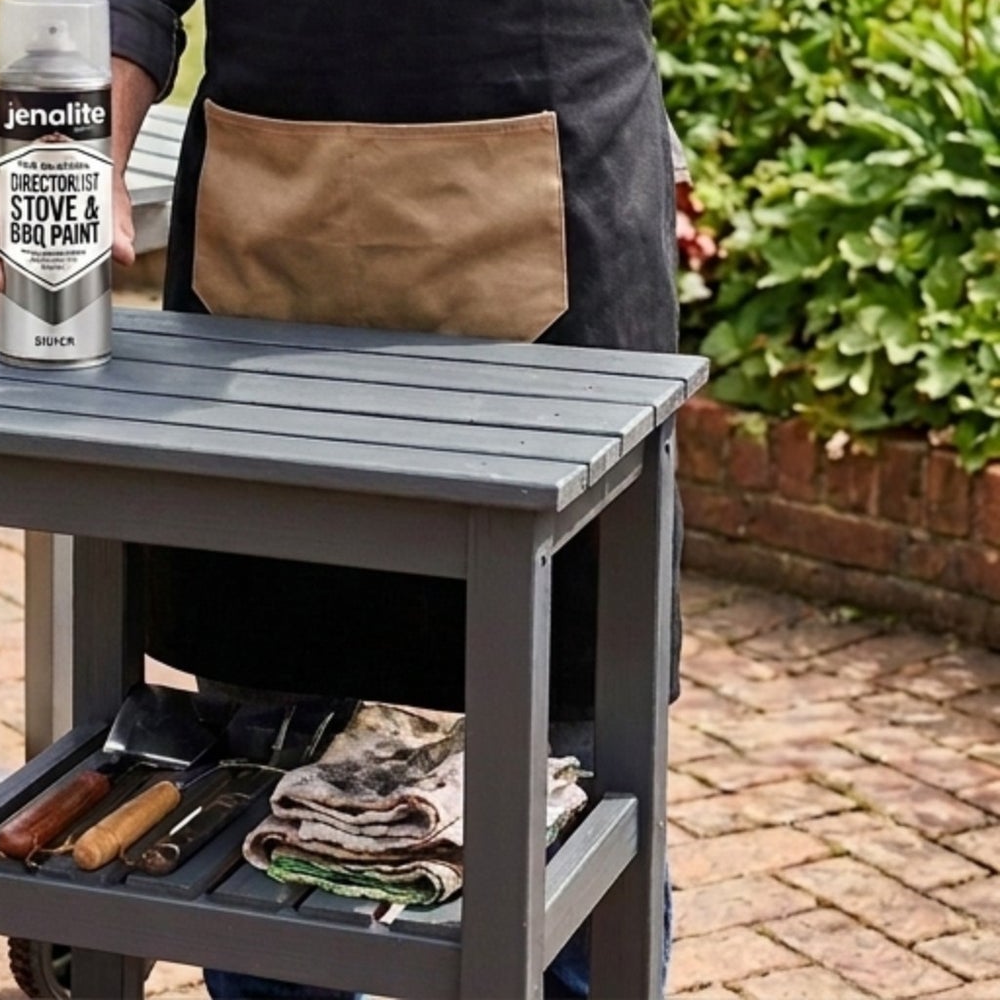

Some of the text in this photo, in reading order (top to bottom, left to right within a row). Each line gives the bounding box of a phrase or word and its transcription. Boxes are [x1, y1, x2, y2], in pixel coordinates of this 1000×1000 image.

[10, 195, 99, 222] STOVE &
[10, 221, 100, 248] BBQ PAINT
